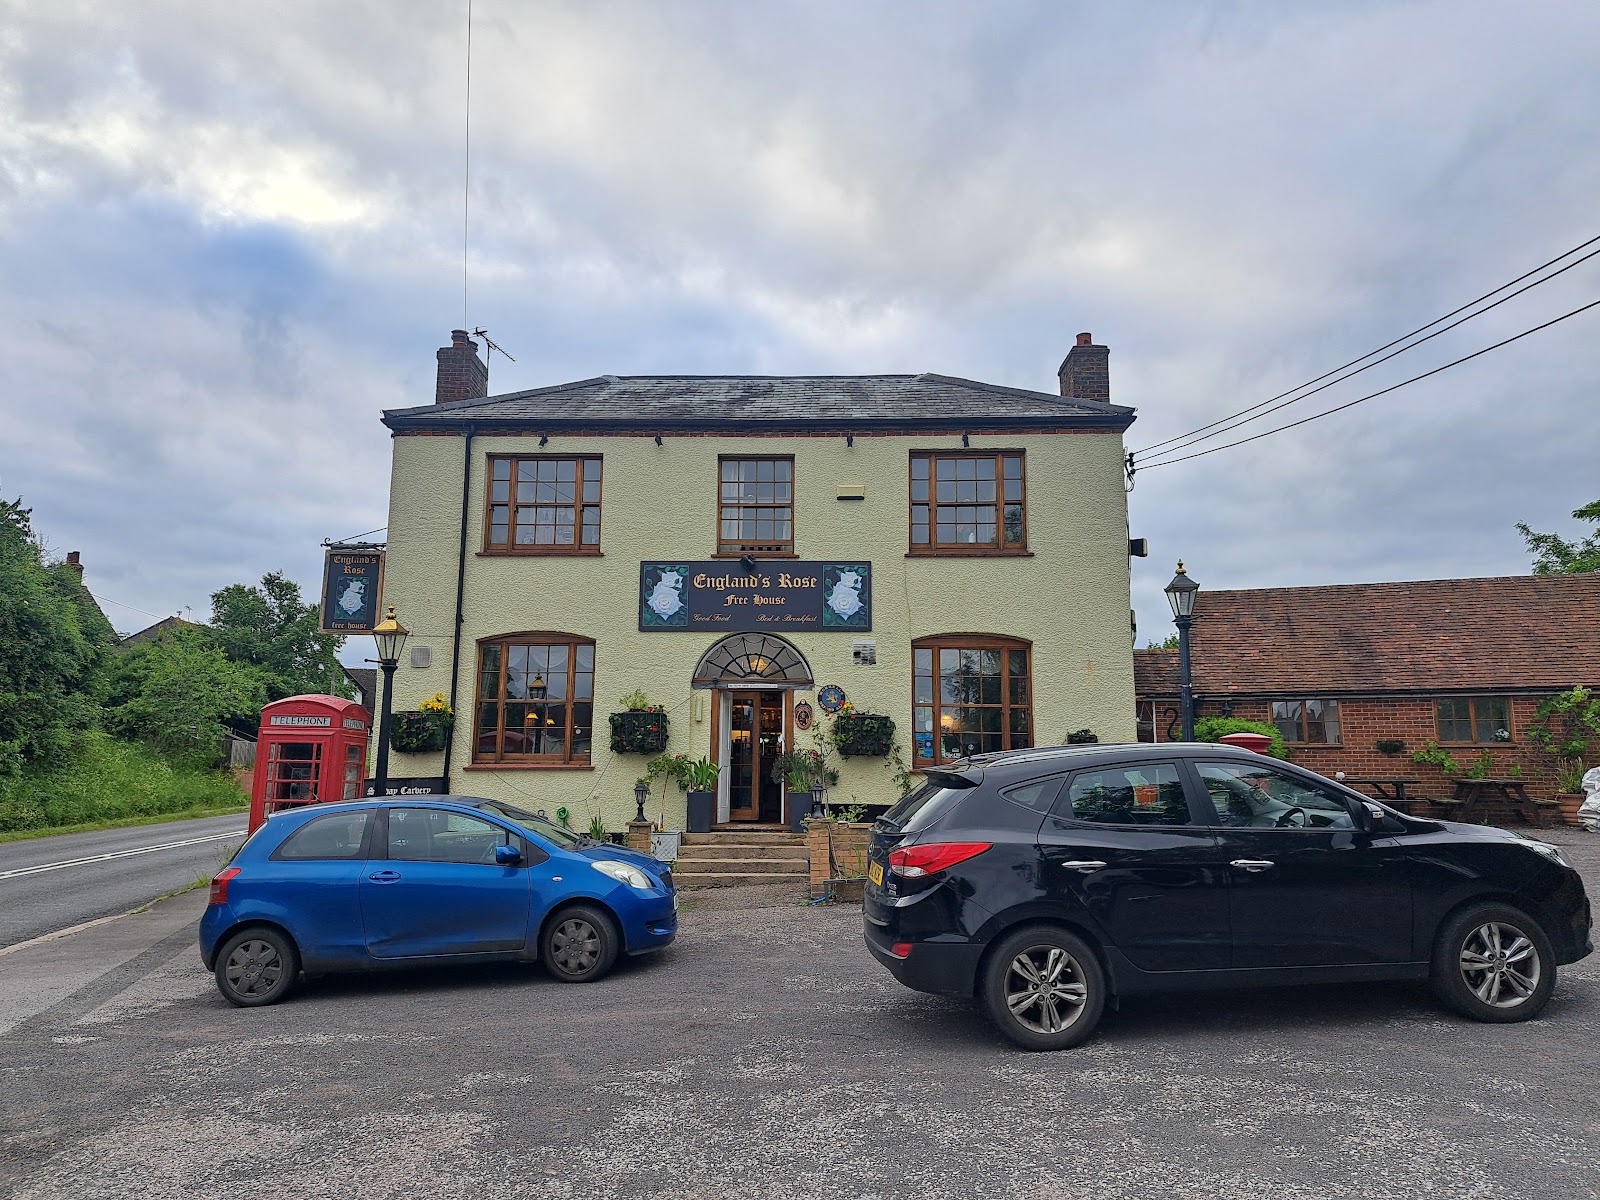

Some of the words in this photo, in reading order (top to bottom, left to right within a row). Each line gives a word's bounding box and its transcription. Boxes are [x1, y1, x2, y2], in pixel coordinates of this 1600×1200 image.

[333, 556, 376, 564] England's
[343, 565, 365, 574] Rose
[693, 573, 771, 591] England's
[778, 573, 817, 588] Rose
[723, 594, 748, 606] Free
[752, 593, 786, 606] House
[692, 613, 712, 622] Good
[712, 613, 731, 622] Food
[755, 614, 773, 622] Bed
[781, 613, 817, 624] Breakfast
[347, 622, 367, 630] house
[273, 716, 328, 726] TELEPHONE
[400, 786, 431, 795] Carvery
